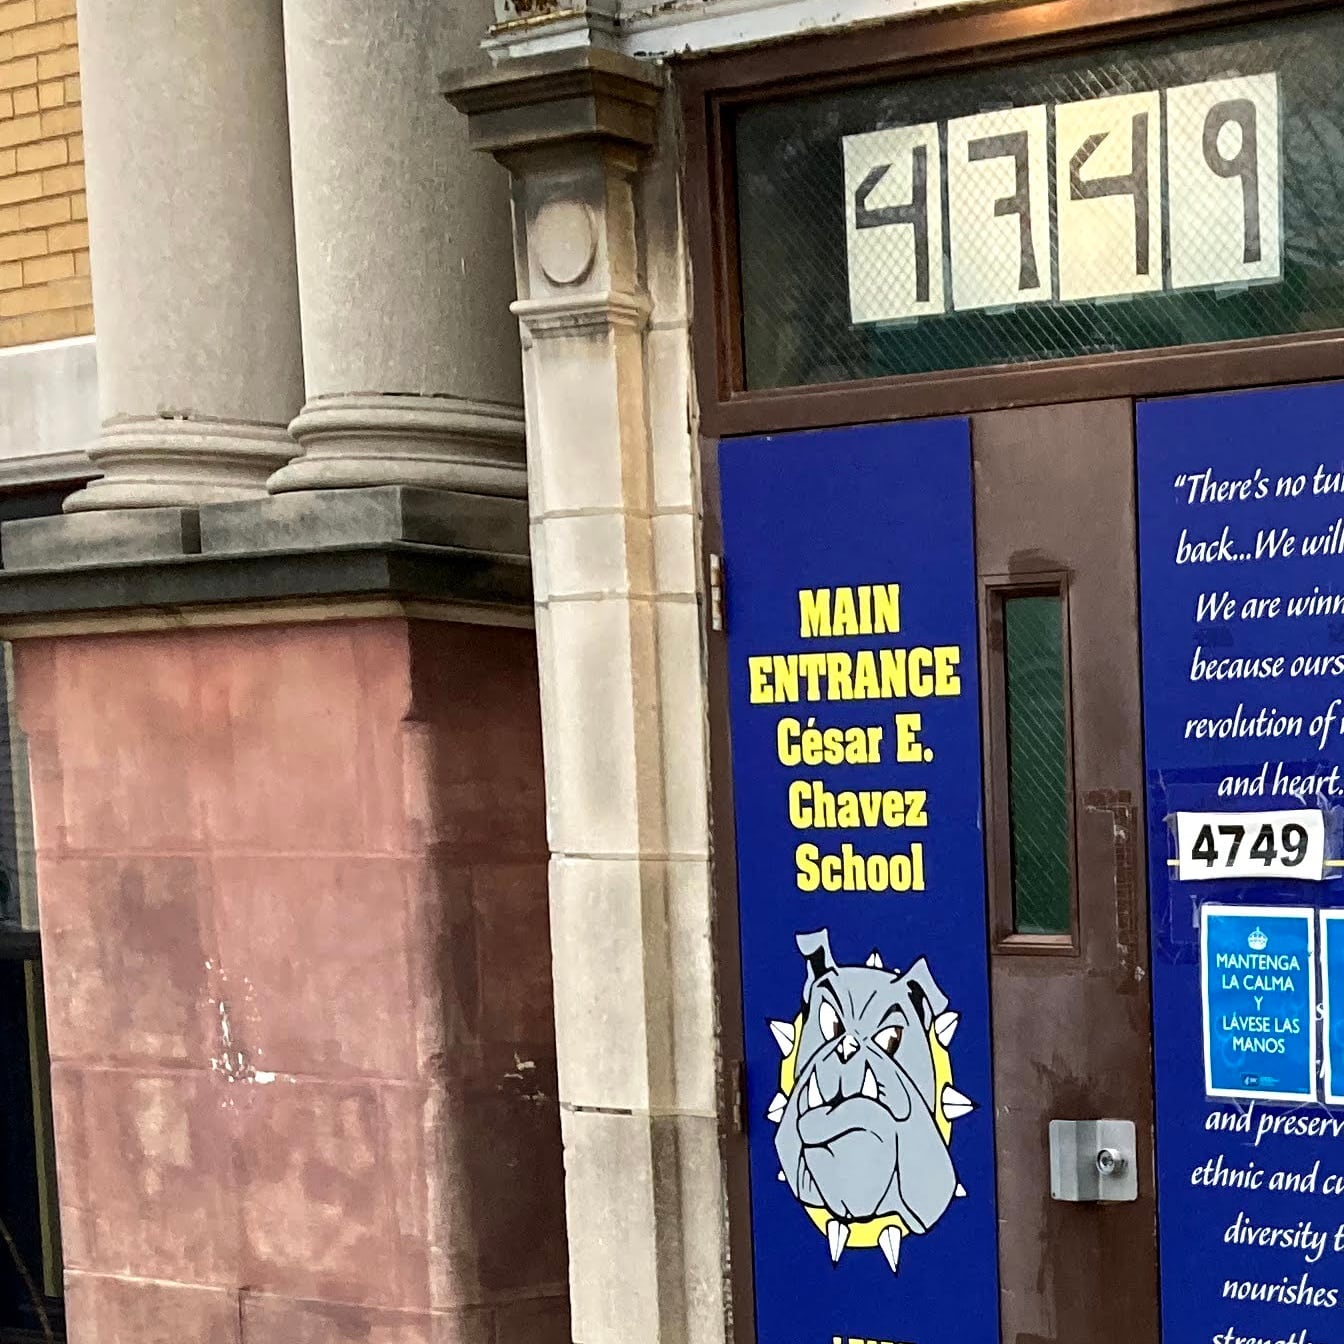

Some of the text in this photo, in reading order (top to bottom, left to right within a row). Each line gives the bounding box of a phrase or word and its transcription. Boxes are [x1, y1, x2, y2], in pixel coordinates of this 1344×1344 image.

[855, 99, 1261, 302] 4749
[1276, 477, 1306, 498] no
[799, 584, 900, 637] MAIN
[1196, 592, 1235, 623] We
[1241, 599, 1281, 620] are
[748, 646, 961, 703] ENTRANCE
[1190, 646, 1284, 681] because
[777, 713, 934, 766] César E.
[1184, 703, 1301, 740] revolution
[1309, 698, 1342, 750] of
[1217, 761, 1269, 798] and
[788, 781, 928, 829] Chavez
[1192, 823, 1309, 868] 4749
[795, 843, 925, 891] School
[1216, 953, 1300, 971] MANTENGA
[1222, 974, 1295, 992] LA CALMA
[1254, 996, 1264, 1011] Y
[1222, 1012, 1300, 1034] LÁVESE LAS
[1233, 1037, 1285, 1054] MANOS
[1205, 1100, 1257, 1133] and
[1190, 1154, 1265, 1190] ethnic
[1268, 1160, 1320, 1194] and
[1223, 1211, 1325, 1263] diversity
[1222, 1273, 1339, 1308] nourishes
